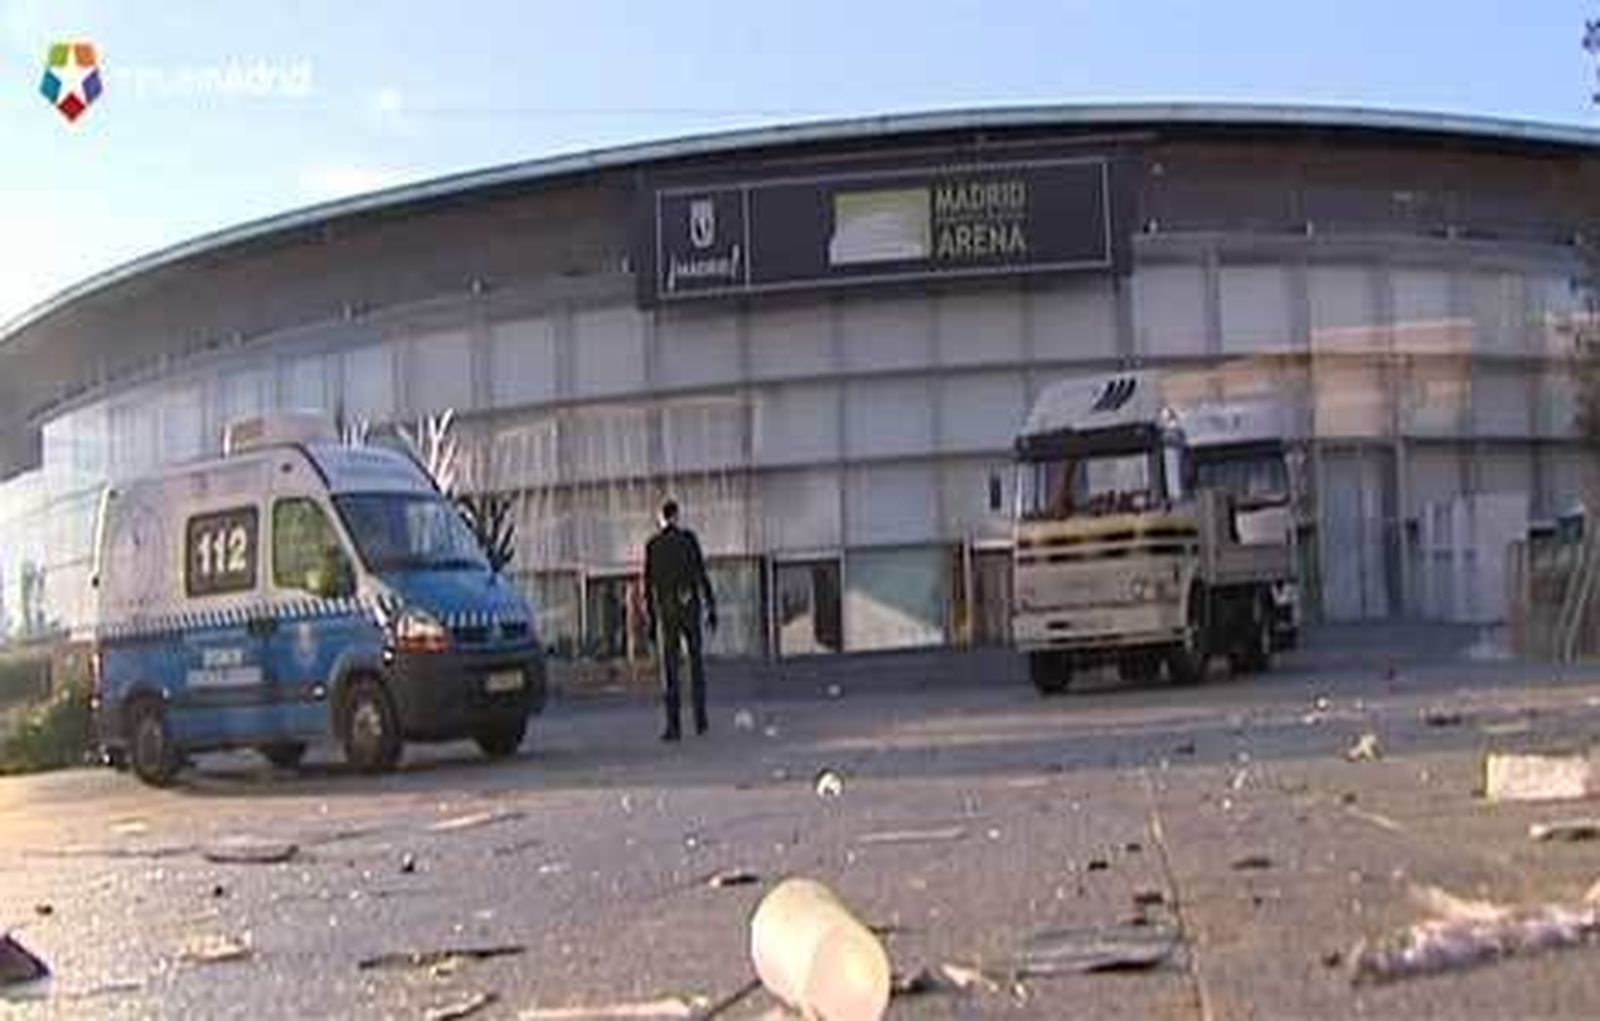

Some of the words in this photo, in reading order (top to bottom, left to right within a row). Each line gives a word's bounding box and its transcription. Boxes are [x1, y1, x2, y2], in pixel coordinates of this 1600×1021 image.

[936, 182, 1027, 214] MADRID
[937, 225, 1027, 258] ARENA
[198, 526, 248, 574] 112
